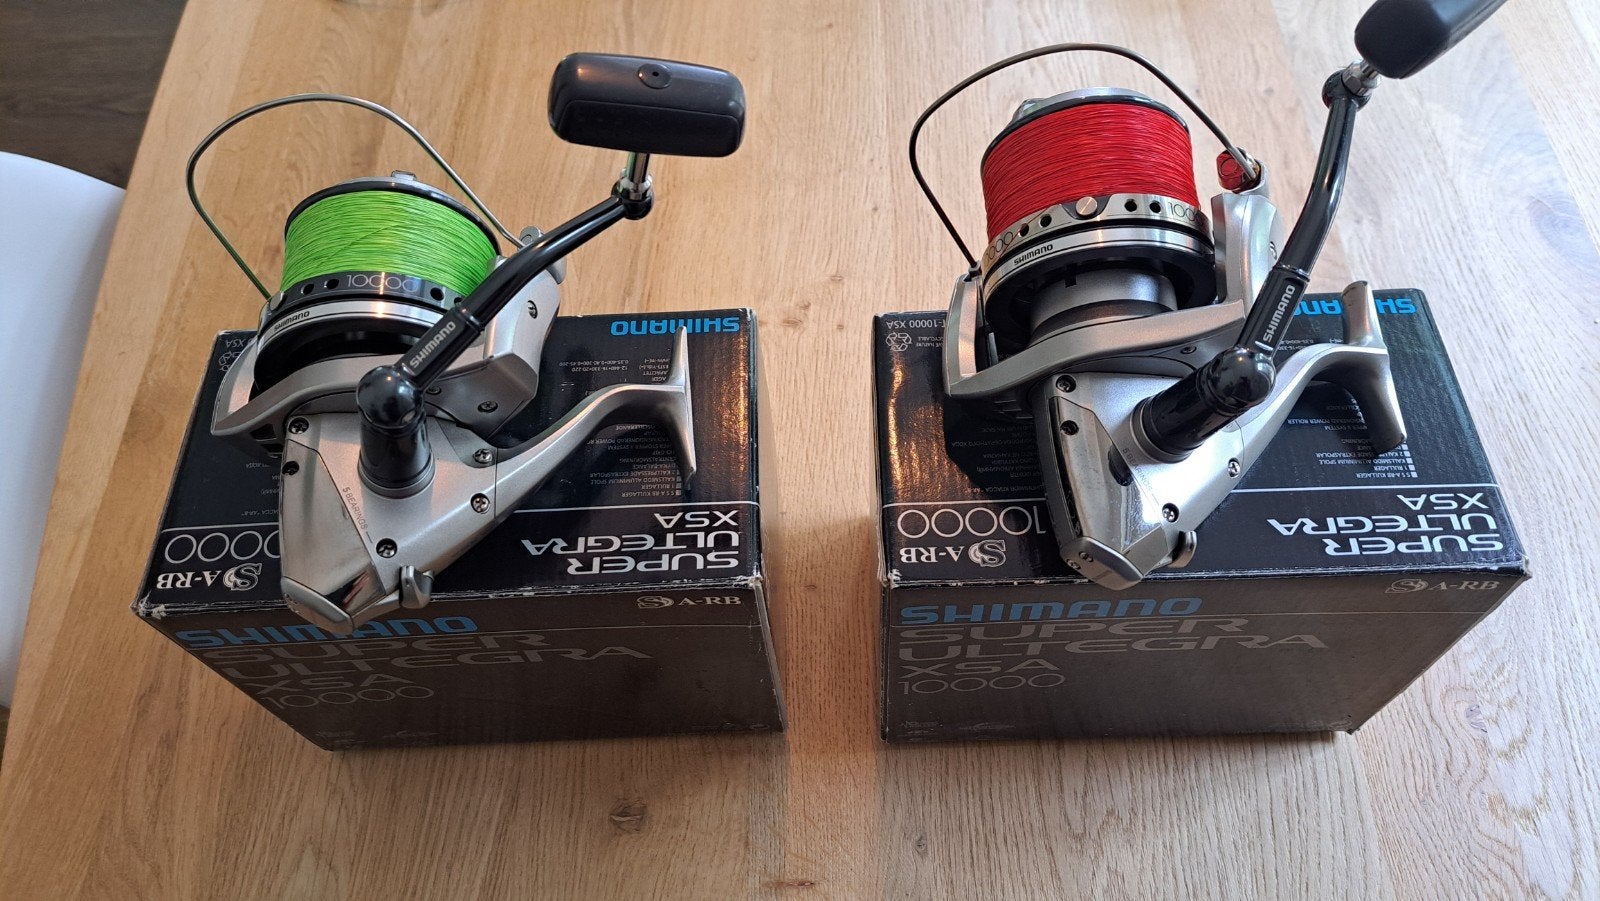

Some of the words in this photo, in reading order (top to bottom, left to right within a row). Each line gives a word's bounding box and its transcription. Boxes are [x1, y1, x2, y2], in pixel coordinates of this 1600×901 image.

[1014, 244, 1053, 266] SHIMANO
[346, 274, 419, 293] 10000
[274, 311, 310, 330] SHIMANO
[886, 320, 907, 329] XSA
[1263, 285, 1295, 343] SHIMANO
[610, 316, 740, 336] SHIMANO
[225, 338, 247, 348] XSA
[409, 321, 456, 368] SHIMANO
[345, 493, 368, 530] BEARINGS
[1396, 492, 1489, 511] XSA
[654, 510, 739, 529] XSA
[897, 505, 1047, 539] 10000
[1266, 513, 1498, 536] ULTEGRA
[521, 530, 739, 556] ULTEGRA
[900, 545, 963, 563] A-RB
[1322, 533, 1504, 556] SUPER
[567, 551, 739, 576] SUPER
[156, 570, 222, 590] A-RB
[679, 596, 742, 606] A-RB
[901, 597, 1203, 625] SHIMANO
[175, 616, 478, 648] SHIMANO
[900, 617, 1250, 644] SUPER
[203, 633, 550, 665] SUPER
[899, 634, 1329, 662] ULTEGRA
[221, 646, 655, 679] ULTEGRA
[901, 658, 1061, 679] XSA
[250, 673, 414, 695] XSA
[898, 673, 1065, 695] 10000
[261, 686, 435, 710] 10000
